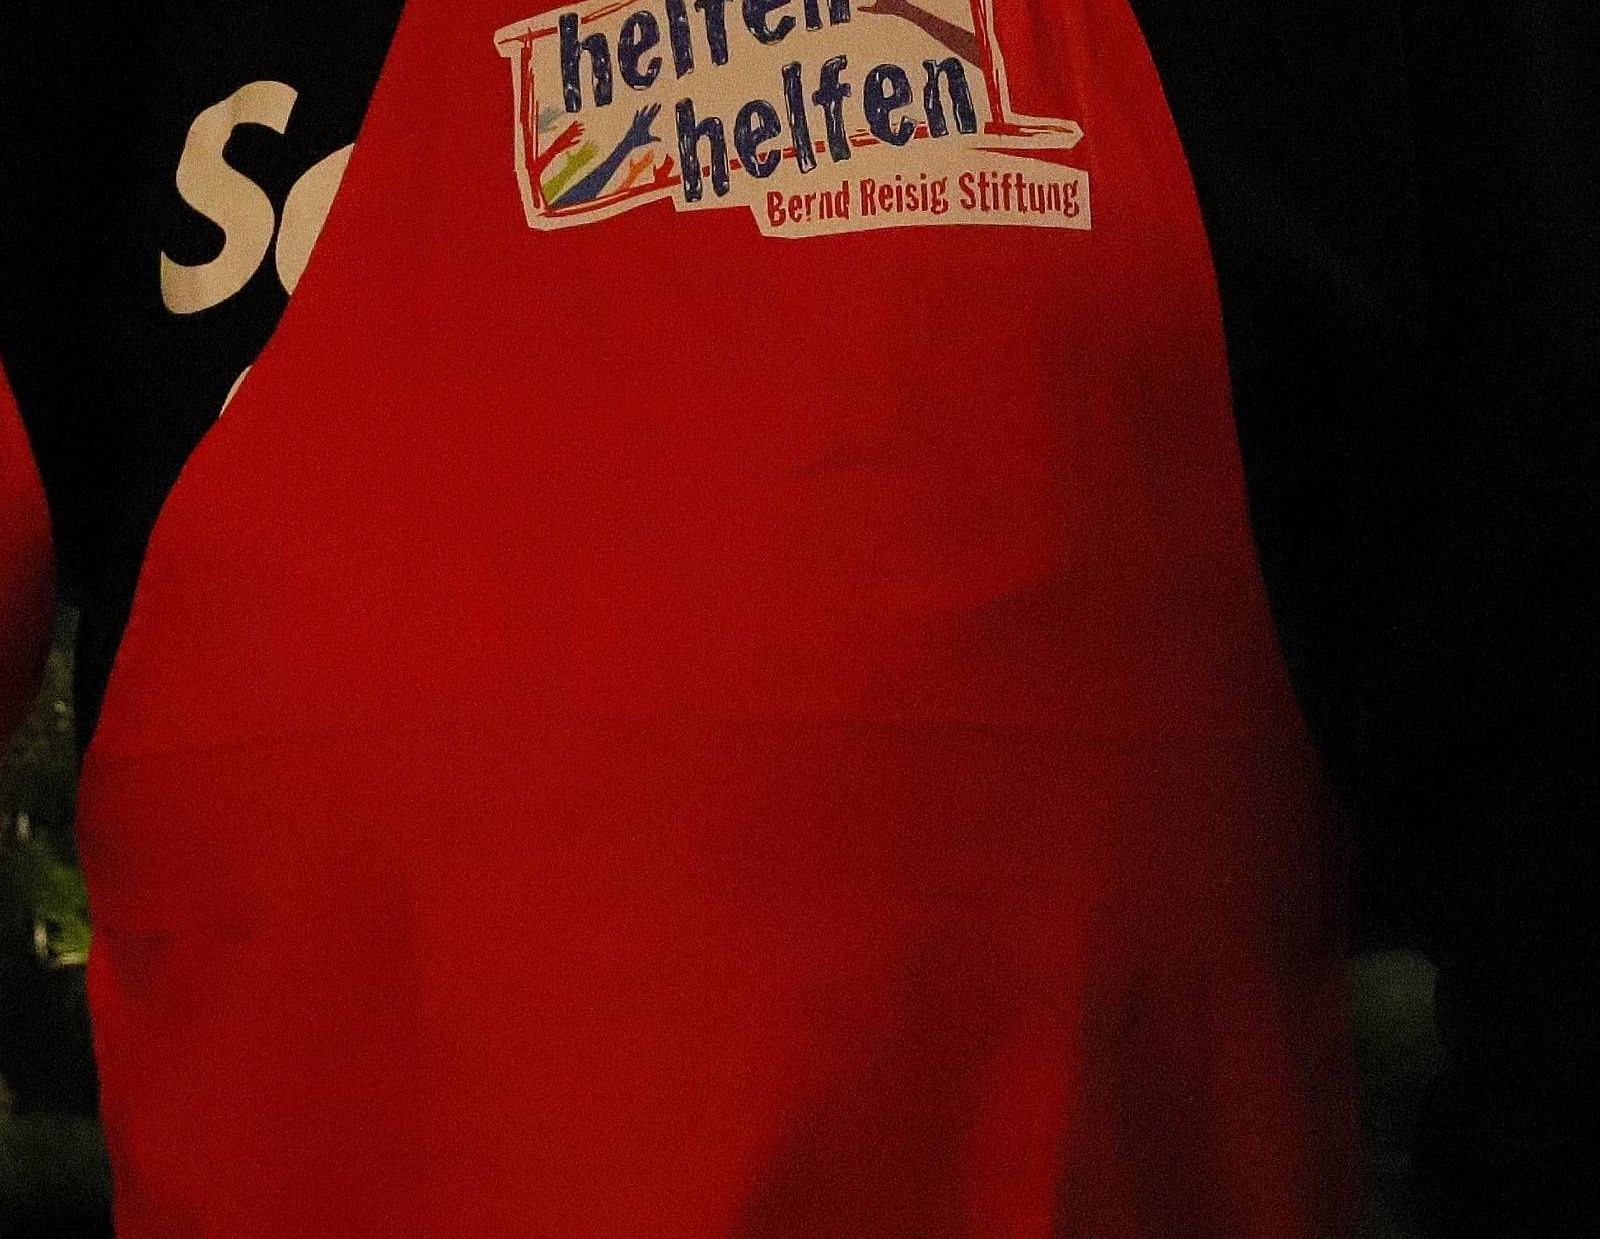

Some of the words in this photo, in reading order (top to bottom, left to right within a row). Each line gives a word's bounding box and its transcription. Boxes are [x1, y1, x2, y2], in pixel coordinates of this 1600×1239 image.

[675, 55, 978, 202] helfen
[766, 186, 851, 227] Bernd
[859, 174, 949, 216] Reisig
[959, 172, 1081, 217] Stiftung
